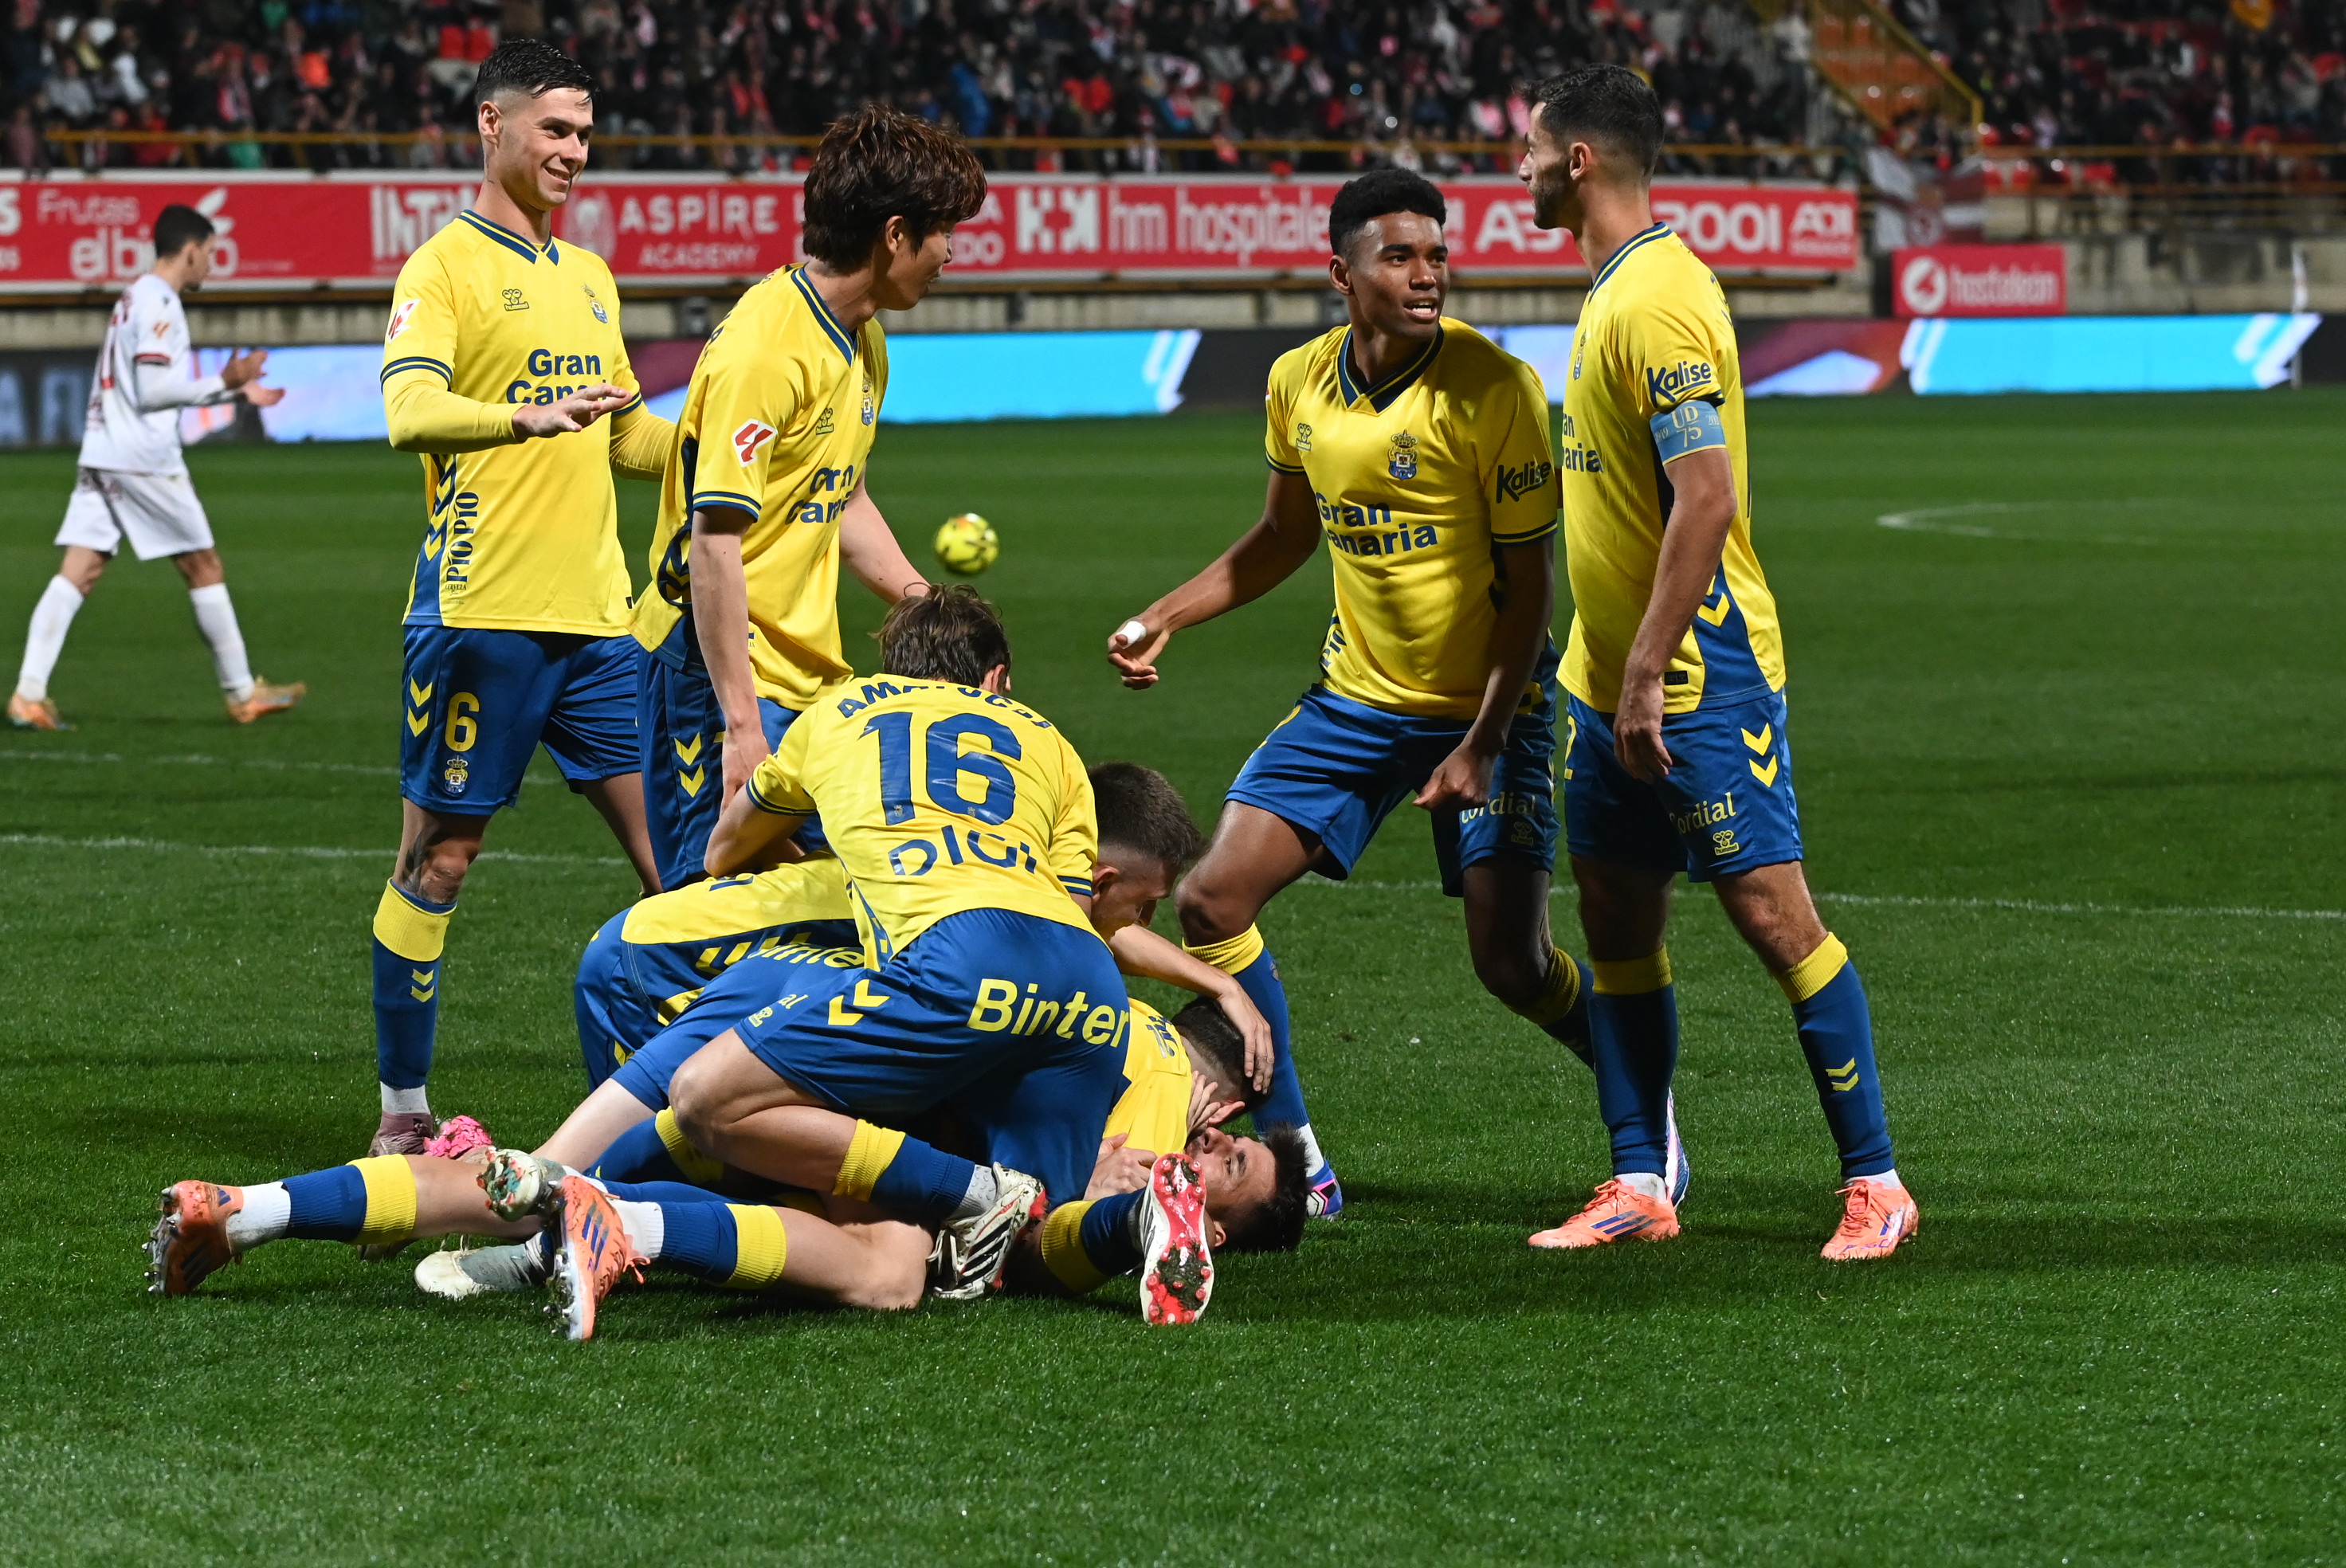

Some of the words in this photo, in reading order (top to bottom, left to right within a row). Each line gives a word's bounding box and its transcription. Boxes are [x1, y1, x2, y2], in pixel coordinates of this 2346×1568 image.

[619, 188, 779, 239] ASPIRE
[1108, 186, 1168, 253] hm
[1175, 186, 1331, 267] hospitale
[528, 348, 602, 377] Gran
[1646, 361, 1712, 408] Kalise
[1671, 406, 1699, 429] UD
[1676, 426, 1703, 448] 75
[1496, 461, 1552, 504] Kalise
[1316, 492, 1392, 527] Gran
[1327, 522, 1438, 555] anaria
[445, 692, 480, 752] 6
[858, 711, 1022, 826] 16
[967, 978, 1130, 1049] Binter
